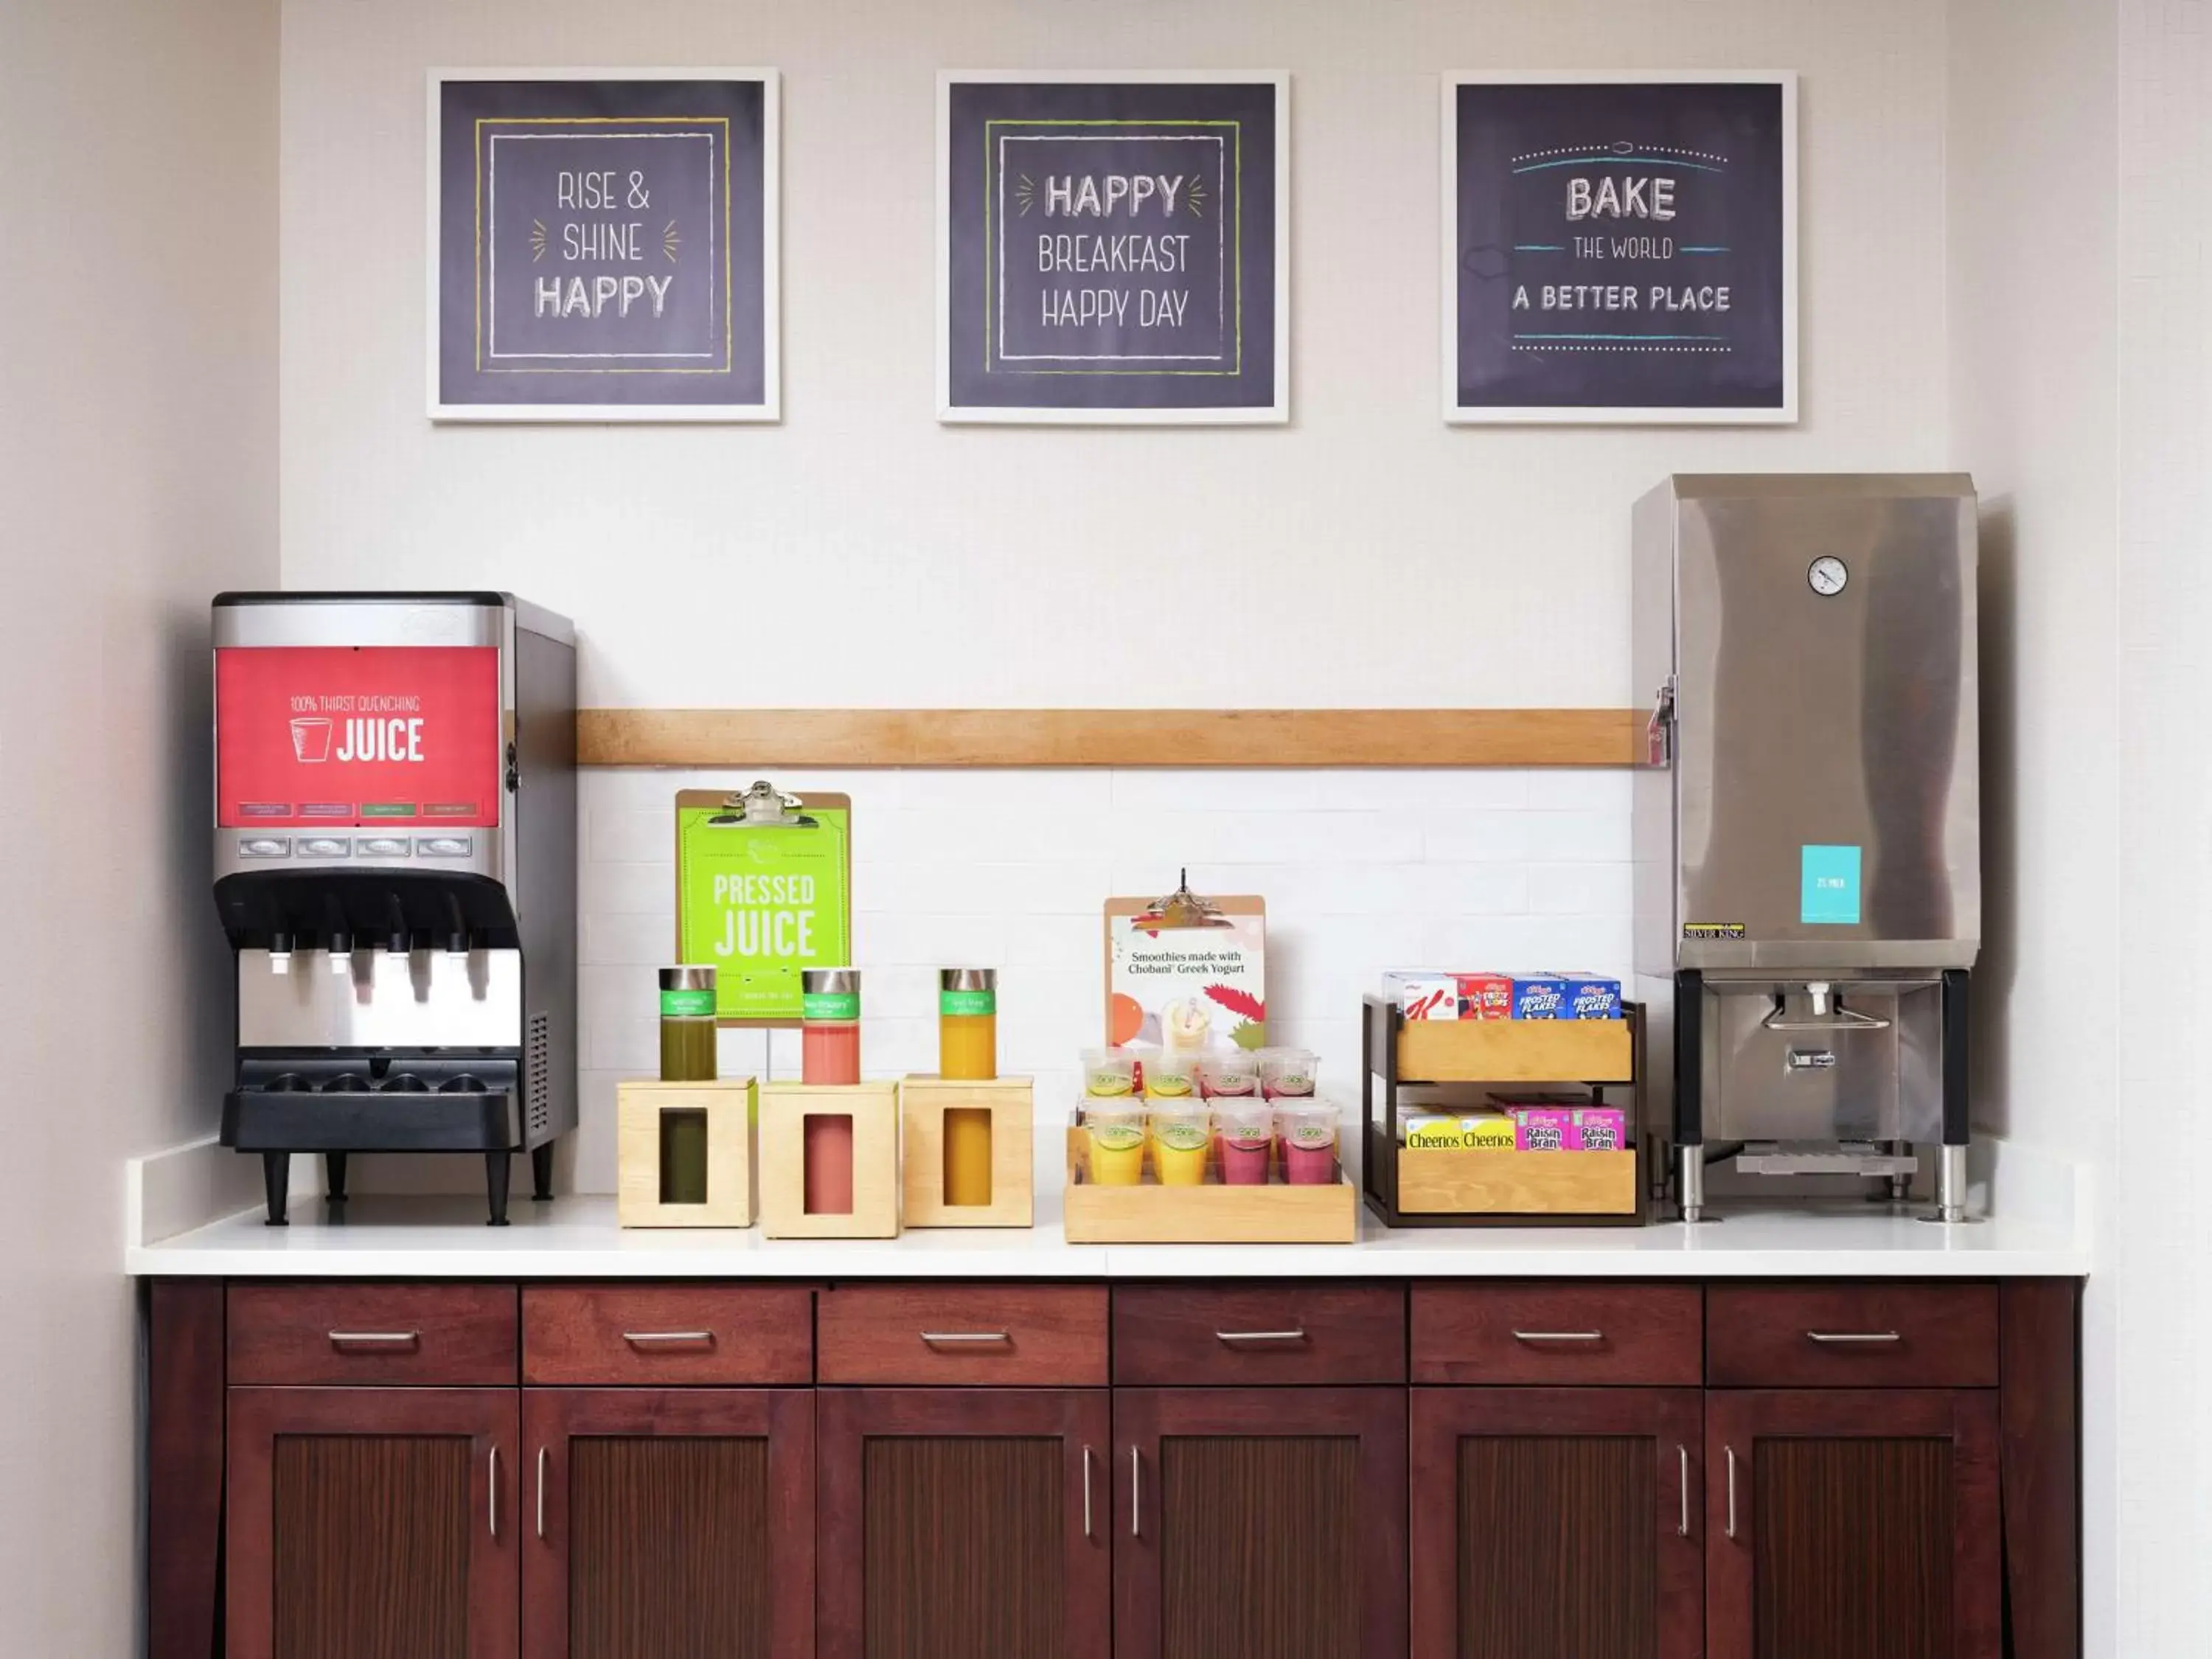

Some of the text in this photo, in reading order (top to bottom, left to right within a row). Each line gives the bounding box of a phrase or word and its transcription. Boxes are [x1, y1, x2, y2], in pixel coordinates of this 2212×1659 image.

[558, 170, 650, 209] RISE &
[1045, 175, 1183, 218] HAPPY
[1566, 176, 1676, 220] BAKE
[563, 223, 643, 261] SHINE
[1574, 237, 1673, 260] THE WORLD
[1038, 234, 1190, 273] BREAKFAST
[535, 276, 672, 319] HAPPY
[1512, 285, 1731, 311] A BETTER PLACE
[1042, 289, 1189, 327] HAPPY DAY
[291, 695, 421, 712] 100% THIRST QUENCHING
[336, 717, 425, 762] JUICE
[714, 873, 815, 905] PRESSED
[714, 910, 817, 957] JUICE
[1685, 929, 1745, 939] SILVER KING
[1132, 951, 1241, 962] Smoothies made with
[1177, 964, 1208, 974] Greek
[1211, 964, 1245, 975] Yogurt
[1519, 993, 1561, 1006] FROSTED
[1573, 993, 1614, 1006] FROSTED
[1521, 1002, 1557, 1015] FLAKES
[1576, 1002, 1610, 1015] FLAKES
[1409, 1133, 1460, 1148] Cheerios
[1464, 1132, 1514, 1147] Cheerios
[1526, 1127, 1561, 1139] Raisin
[1582, 1127, 1615, 1139] Raisin
[1530, 1138, 1557, 1148] Bran
[1586, 1138, 1613, 1148] Bran
